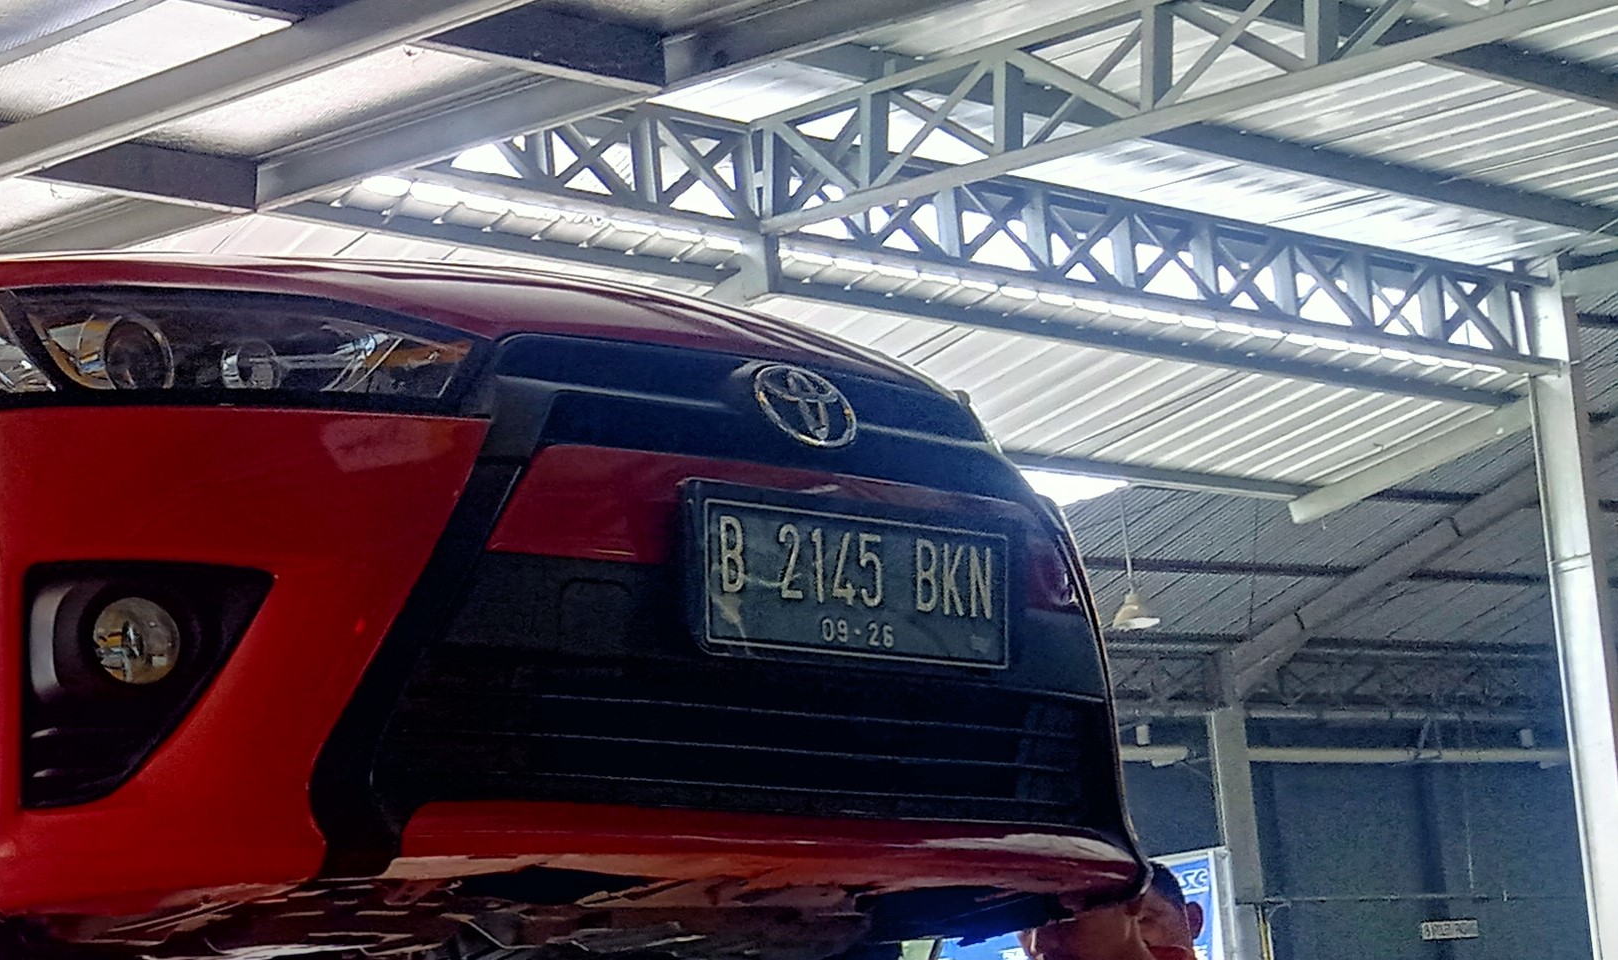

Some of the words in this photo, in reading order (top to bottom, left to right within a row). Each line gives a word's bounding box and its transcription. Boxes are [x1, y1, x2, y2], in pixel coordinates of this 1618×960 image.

[719, 515, 745, 593] B
[778, 523, 883, 608] 2145
[915, 538, 993, 620] BKN
